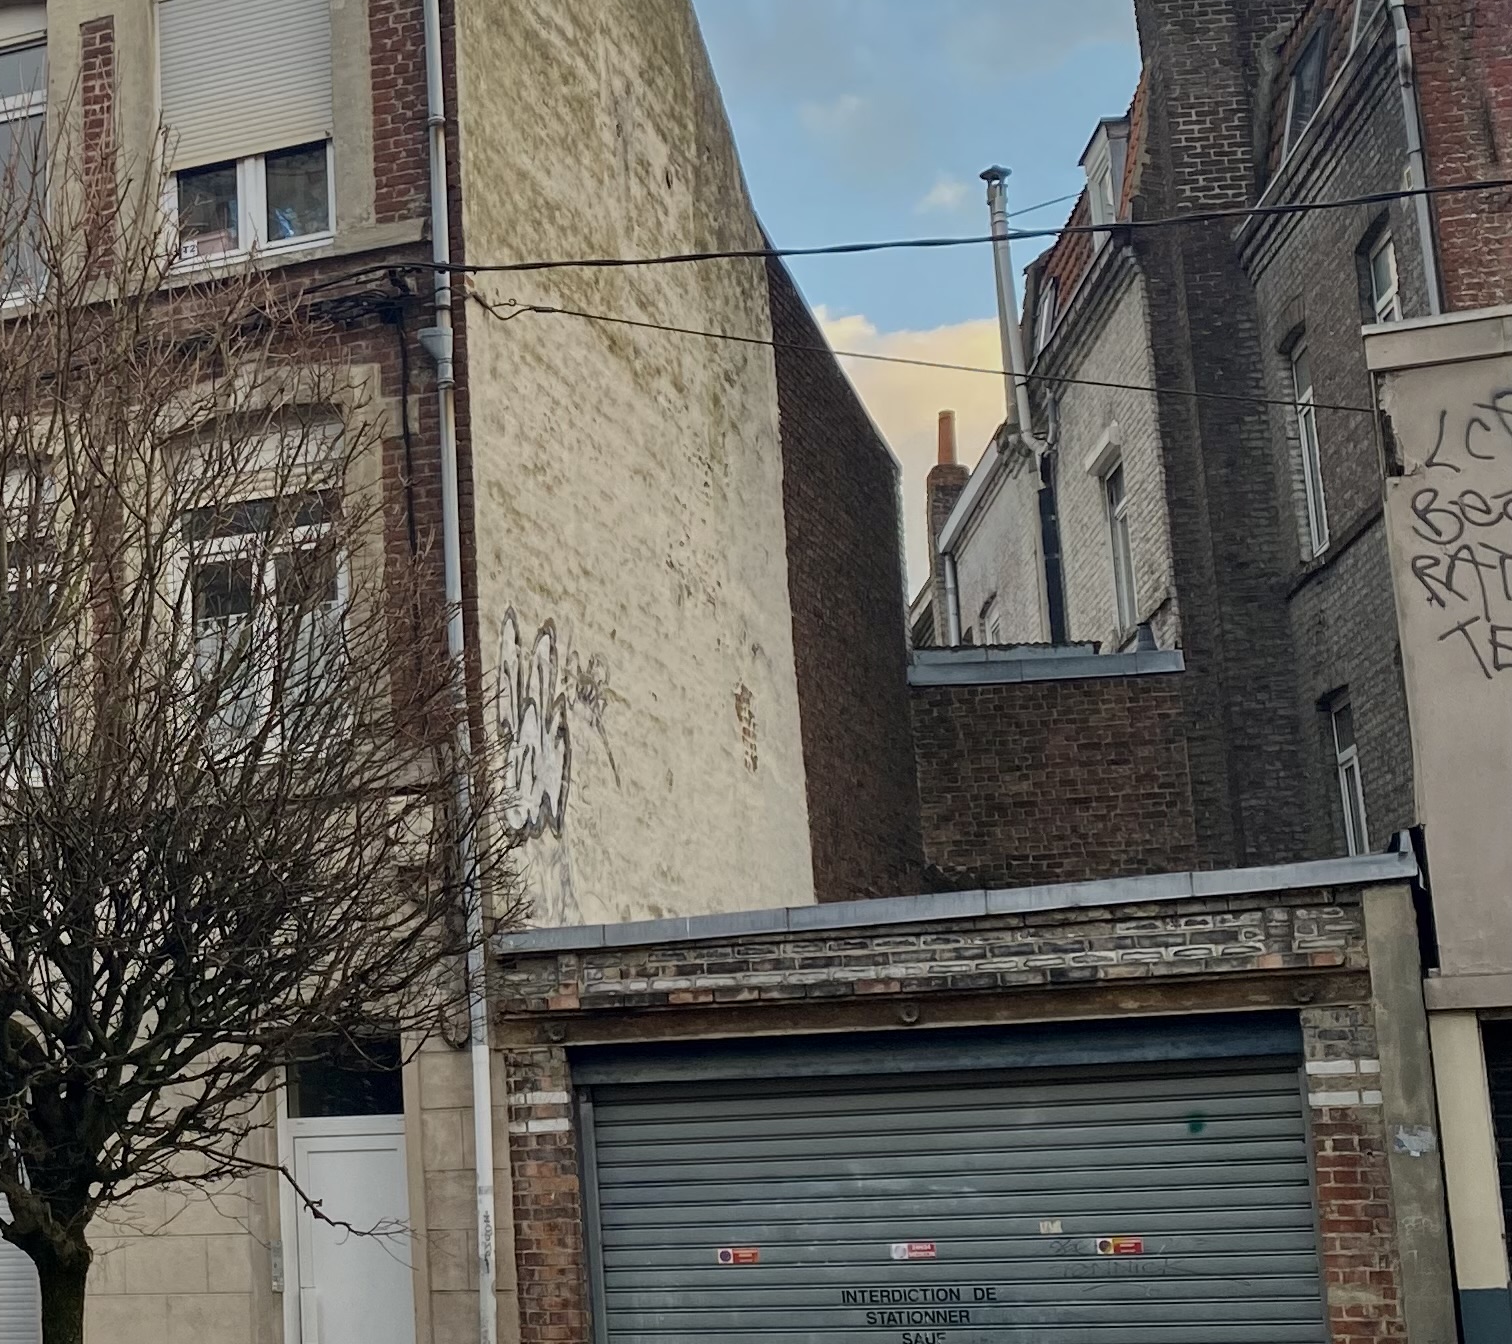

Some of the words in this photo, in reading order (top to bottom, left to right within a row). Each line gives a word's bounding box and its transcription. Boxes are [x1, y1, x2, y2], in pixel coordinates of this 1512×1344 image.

[841, 1288, 961, 1303] INTERDICTION
[973, 1287, 997, 1301] DE
[866, 1310, 970, 1325] STATIONNER
